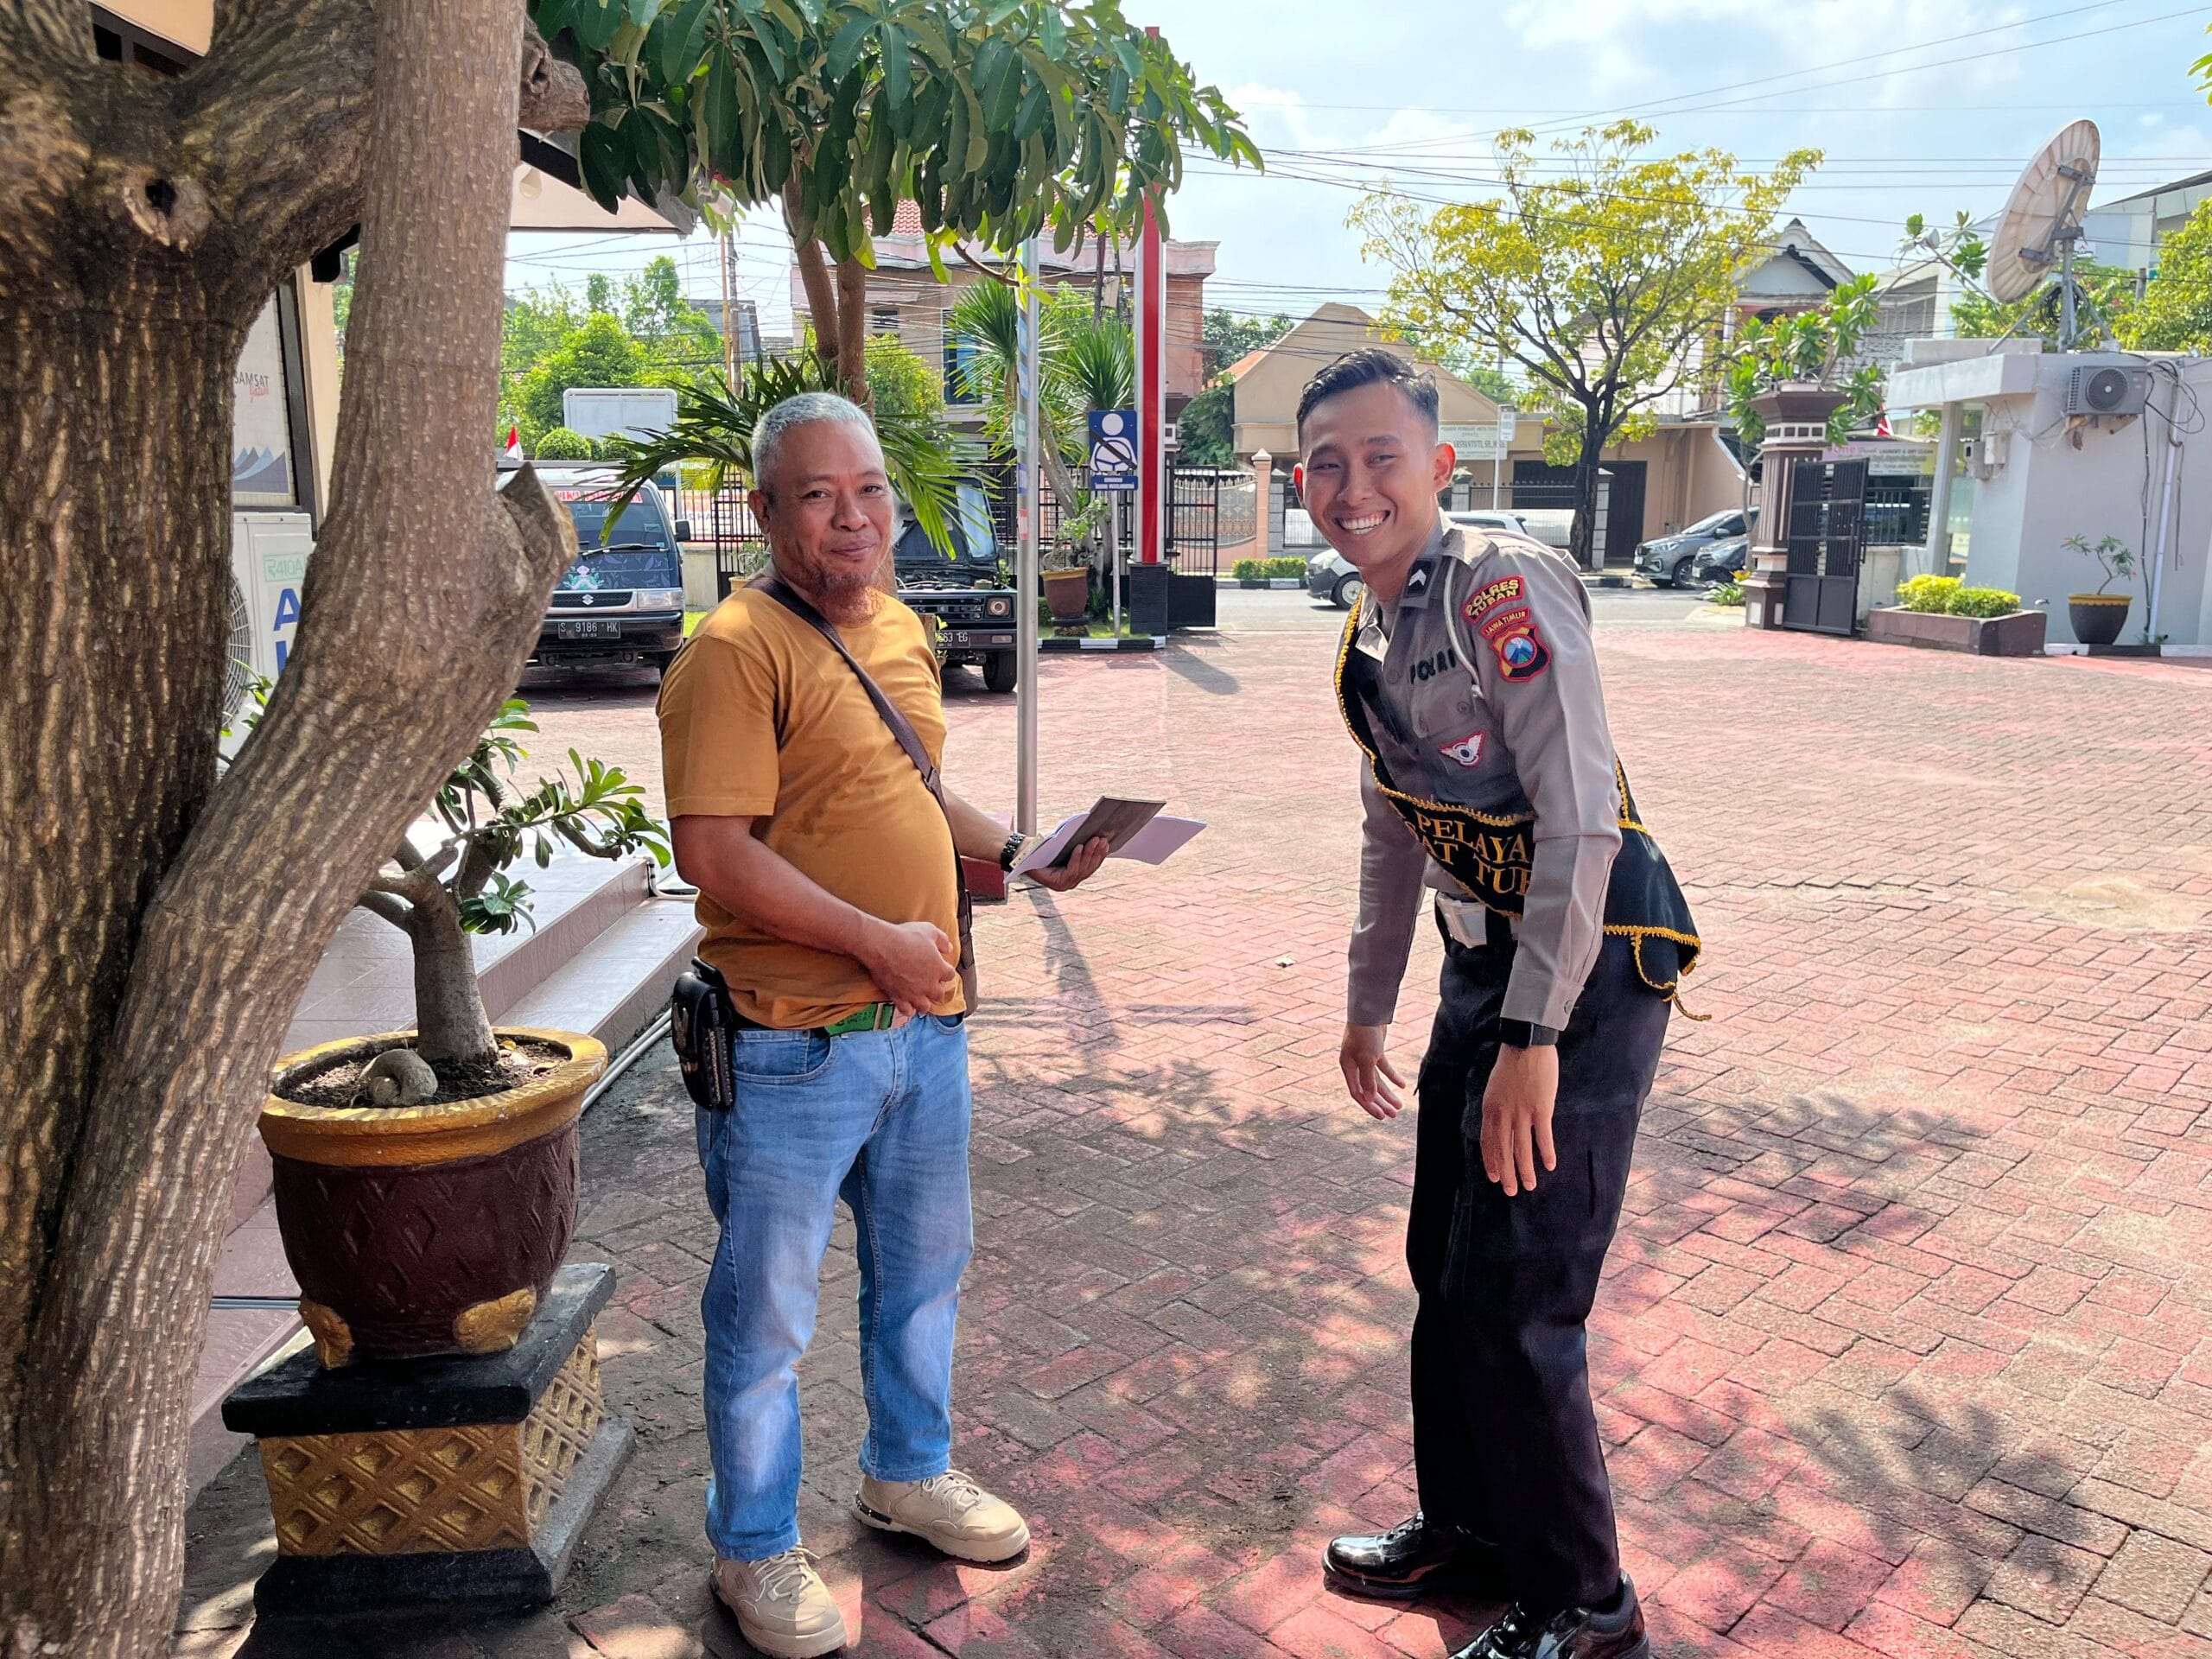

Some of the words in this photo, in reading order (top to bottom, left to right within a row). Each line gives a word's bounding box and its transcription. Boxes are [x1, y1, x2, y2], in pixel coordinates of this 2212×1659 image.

[234, 372, 269, 387] SAMSAT
[266, 558, 303, 578] R410A
[1465, 579, 1519, 616] POLRES
[1471, 588, 1516, 616] TUBAN
[560, 622, 566, 632] S
[575, 622, 598, 632] 9186
[607, 621, 618, 632] HK
[1484, 619, 1503, 635] JAWA
[1502, 611, 1526, 624] TIMUR
[958, 632, 968, 643] EG
